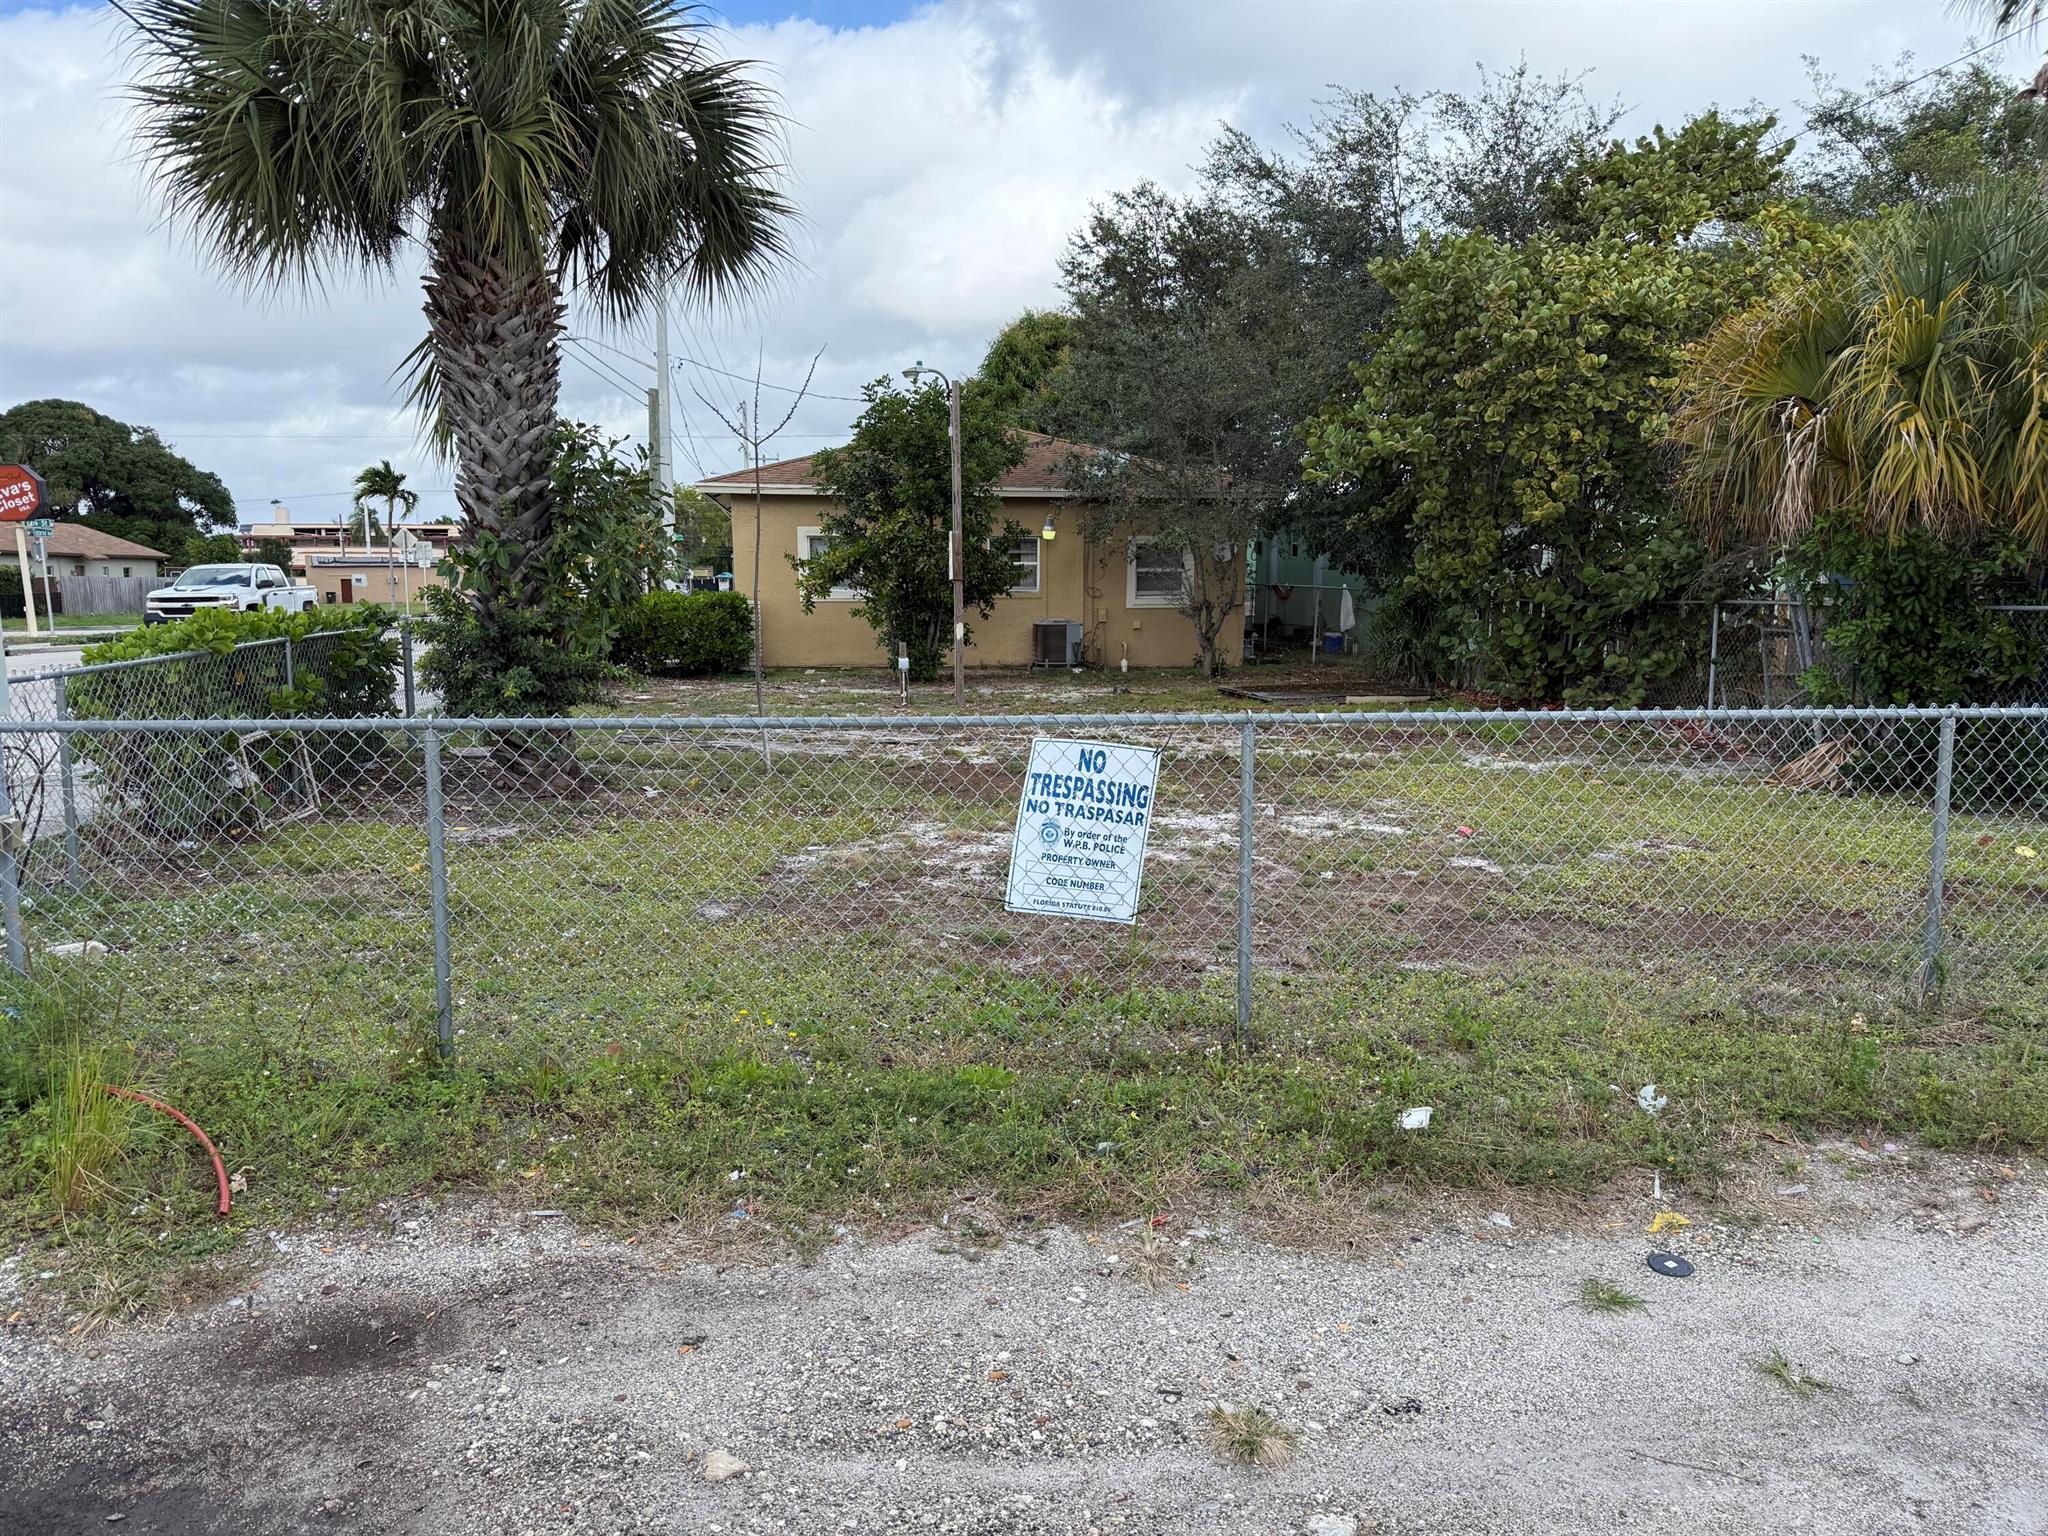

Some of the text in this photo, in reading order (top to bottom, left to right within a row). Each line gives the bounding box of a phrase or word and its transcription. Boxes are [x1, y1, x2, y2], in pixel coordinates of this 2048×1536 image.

[1078, 748, 1107, 774] NO
[1030, 772, 1150, 809] TRESPASSING
[1025, 799, 1145, 827] NO TRASPASAR
[1064, 827, 1128, 843] By order of the
[1093, 842, 1126, 855] POLICE
[1041, 852, 1116, 869] PROPERTY OWNER
[1046, 877, 1105, 891] CODE NUMBER
[1033, 898, 1061, 907] FLORIDA
[1062, 901, 1091, 911] STATUTE
